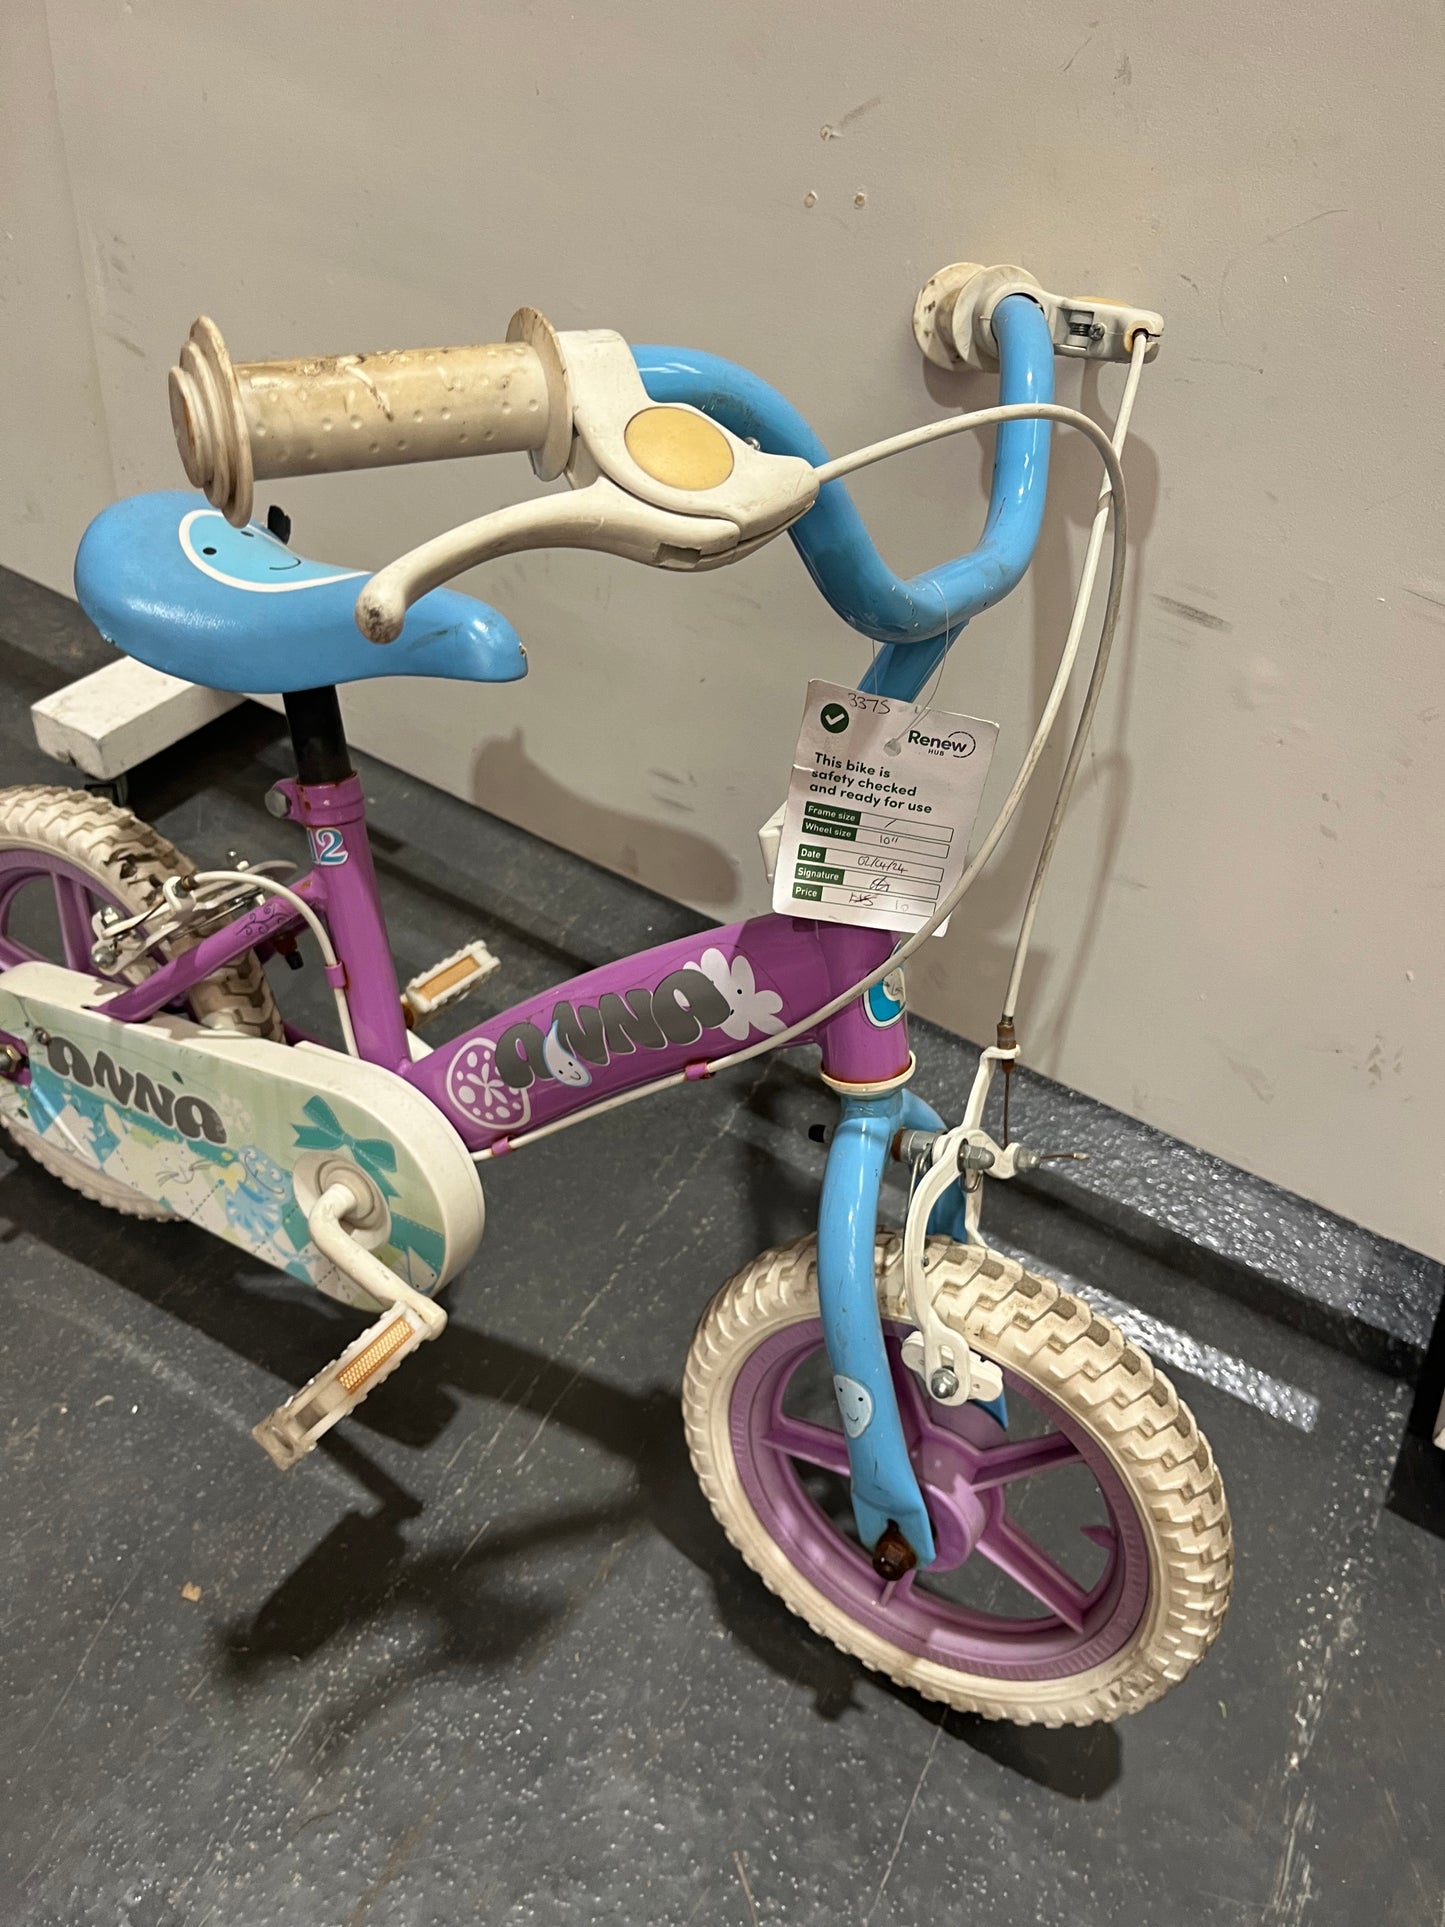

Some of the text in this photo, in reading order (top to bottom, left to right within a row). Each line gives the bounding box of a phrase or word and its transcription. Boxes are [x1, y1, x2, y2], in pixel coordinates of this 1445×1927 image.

[907, 729, 968, 753] Renew
[927, 748, 945, 757] HUB
[814, 752, 891, 778] This bike is
[811, 769, 917, 797] safety checked
[809, 782, 933, 814] and ready for use
[807, 804, 857, 822] Frame size
[804, 821, 852, 838] Wheel size
[800, 847, 822, 859] Date
[797, 867, 840, 882] Signature
[794, 886, 818, 898] Price
